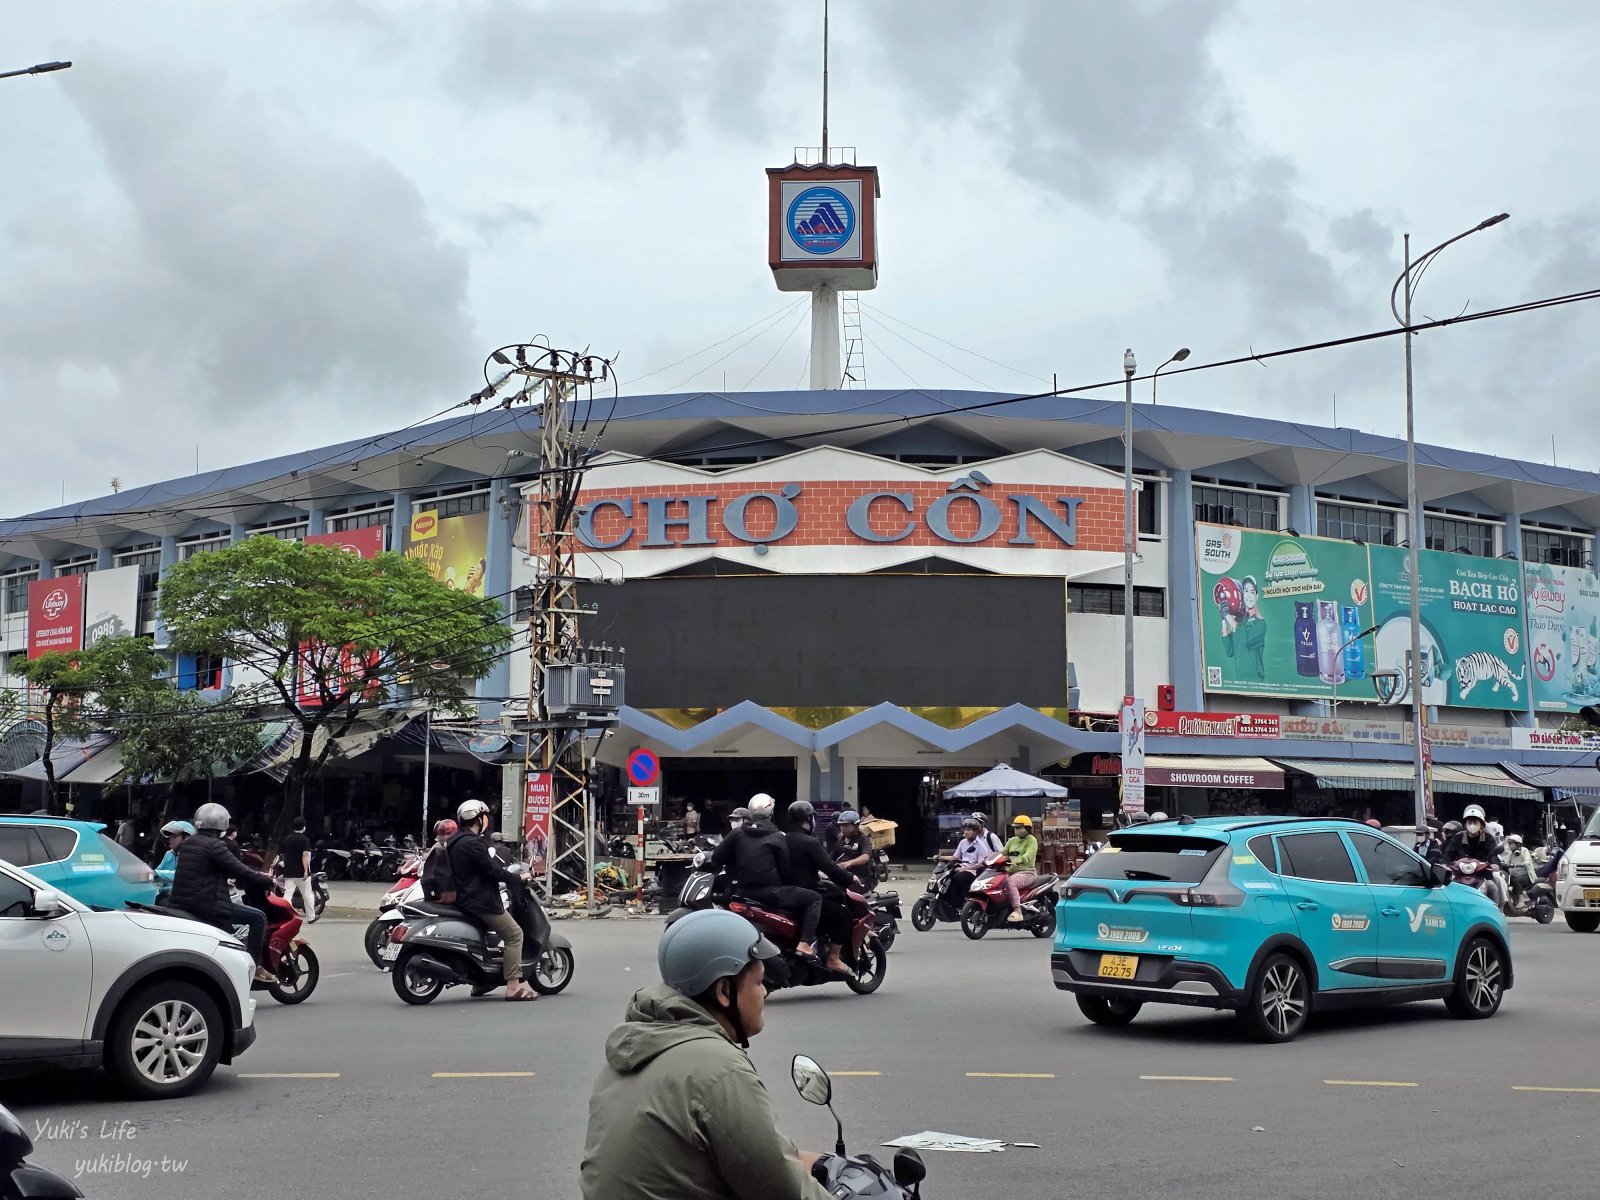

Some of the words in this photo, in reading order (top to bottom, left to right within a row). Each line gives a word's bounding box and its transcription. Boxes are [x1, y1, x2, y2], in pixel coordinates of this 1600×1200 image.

[574, 482, 801, 555] CHỢ
[846, 470, 1083, 547] CỒN
[1206, 539, 1222, 549] GAS
[1204, 548, 1231, 559] SOUTH
[1449, 579, 1493, 600] BẠCH
[1497, 579, 1518, 602] HỔ
[1453, 600, 1478, 612] HOẠT
[1479, 603, 1497, 614] LẠC
[1498, 605, 1516, 615] CAO
[1170, 773, 1221, 784] SHOWROOM
[1223, 774, 1255, 785] COFFEE
[530, 784, 545, 793] MUA
[545, 784, 549, 793] 1
[545, 796, 550, 805] 3
[637, 791, 650, 799] 30m
[1109, 930, 1124, 939] 1900
[1110, 956, 1126, 967] 43E
[1102, 966, 1131, 978] 022.75
